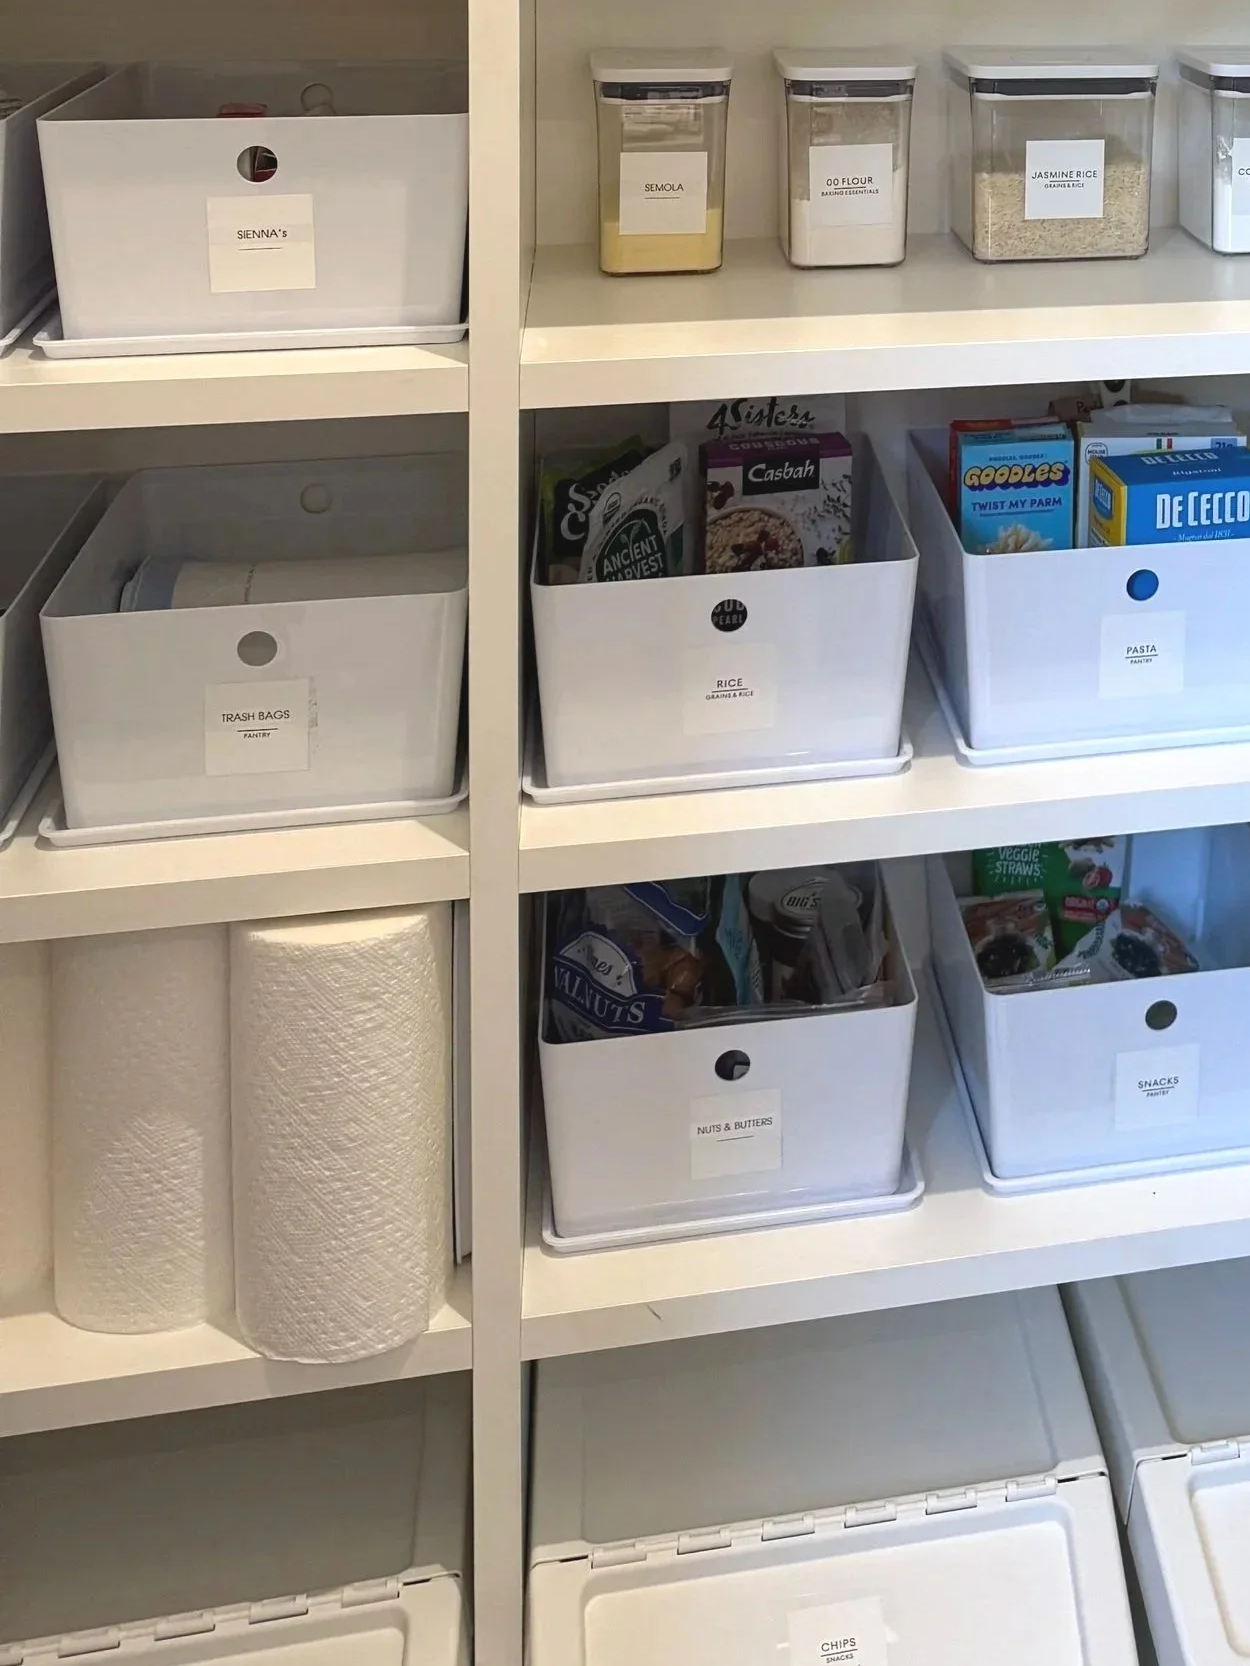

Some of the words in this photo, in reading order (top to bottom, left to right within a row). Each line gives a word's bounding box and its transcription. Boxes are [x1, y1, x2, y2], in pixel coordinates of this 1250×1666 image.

[842, 176, 873, 186] FLOUR
[1031, 170, 1074, 180] JASMINE
[1076, 170, 1098, 179] RICE
[644, 183, 684, 192] SEMOLA
[845, 188, 879, 196] ESSENTIALS
[729, 437, 821, 451] COUSCOUS
[1167, 451, 1219, 464] CECCO
[748, 459, 816, 482] Casbah
[964, 462, 1068, 490] GOODLES
[971, 500, 1005, 512] TWIST
[1008, 499, 1027, 510] MY
[1030, 496, 1062, 509] PARM
[1156, 493, 1183, 529] DE
[1187, 490, 1250, 526] CECCO
[603, 534, 660, 577] ANCIENT
[1126, 644, 1157, 655] PASTA
[717, 678, 743, 689] RICE
[706, 692, 731, 701] GRAINS
[739, 690, 754, 698] RICE
[222, 712, 255, 723] TRASH
[258, 710, 290, 721] BAGS
[243, 731, 271, 739] PANTRY
[995, 861, 1042, 877] STRAWS
[1137, 1076, 1179, 1089] SNACKS
[697, 1124, 721, 1135] NUTS
[724, 1122, 731, 1131] &
[734, 1117, 773, 1130] BUTTERS
[821, 1637, 857, 1652] CHIPS
[826, 1653, 854, 1664] SNACKS
